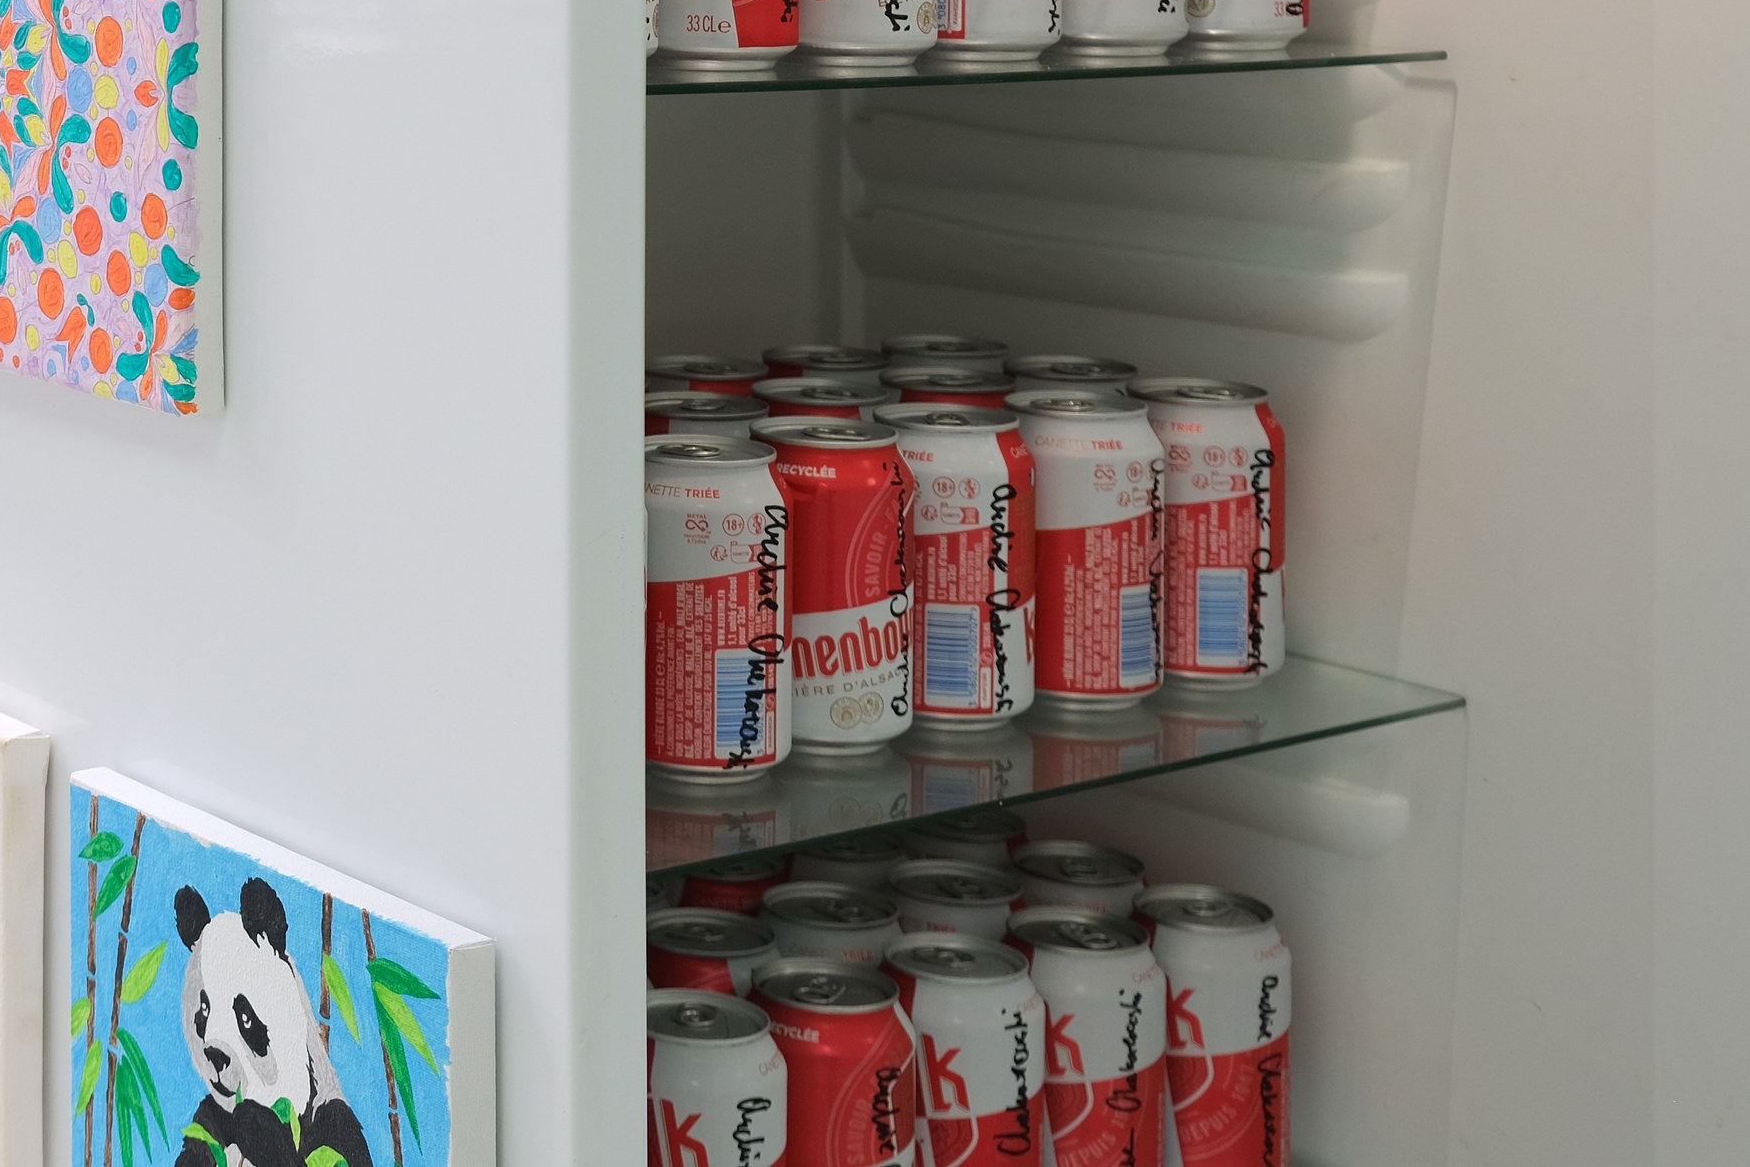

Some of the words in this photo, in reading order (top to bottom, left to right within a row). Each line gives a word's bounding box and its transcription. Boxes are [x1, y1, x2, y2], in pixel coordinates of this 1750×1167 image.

[687, 14, 699, 32] 33
[1091, 440, 1123, 450] TRIÉE
[645, 483, 681, 497] NETTE
[685, 487, 720, 499] TRIÉE
[937, 482, 953, 493] 18+
[726, 519, 743, 531] 18+
[795, 684, 835, 697] IÈRE
[921, 1033, 971, 1113] K
